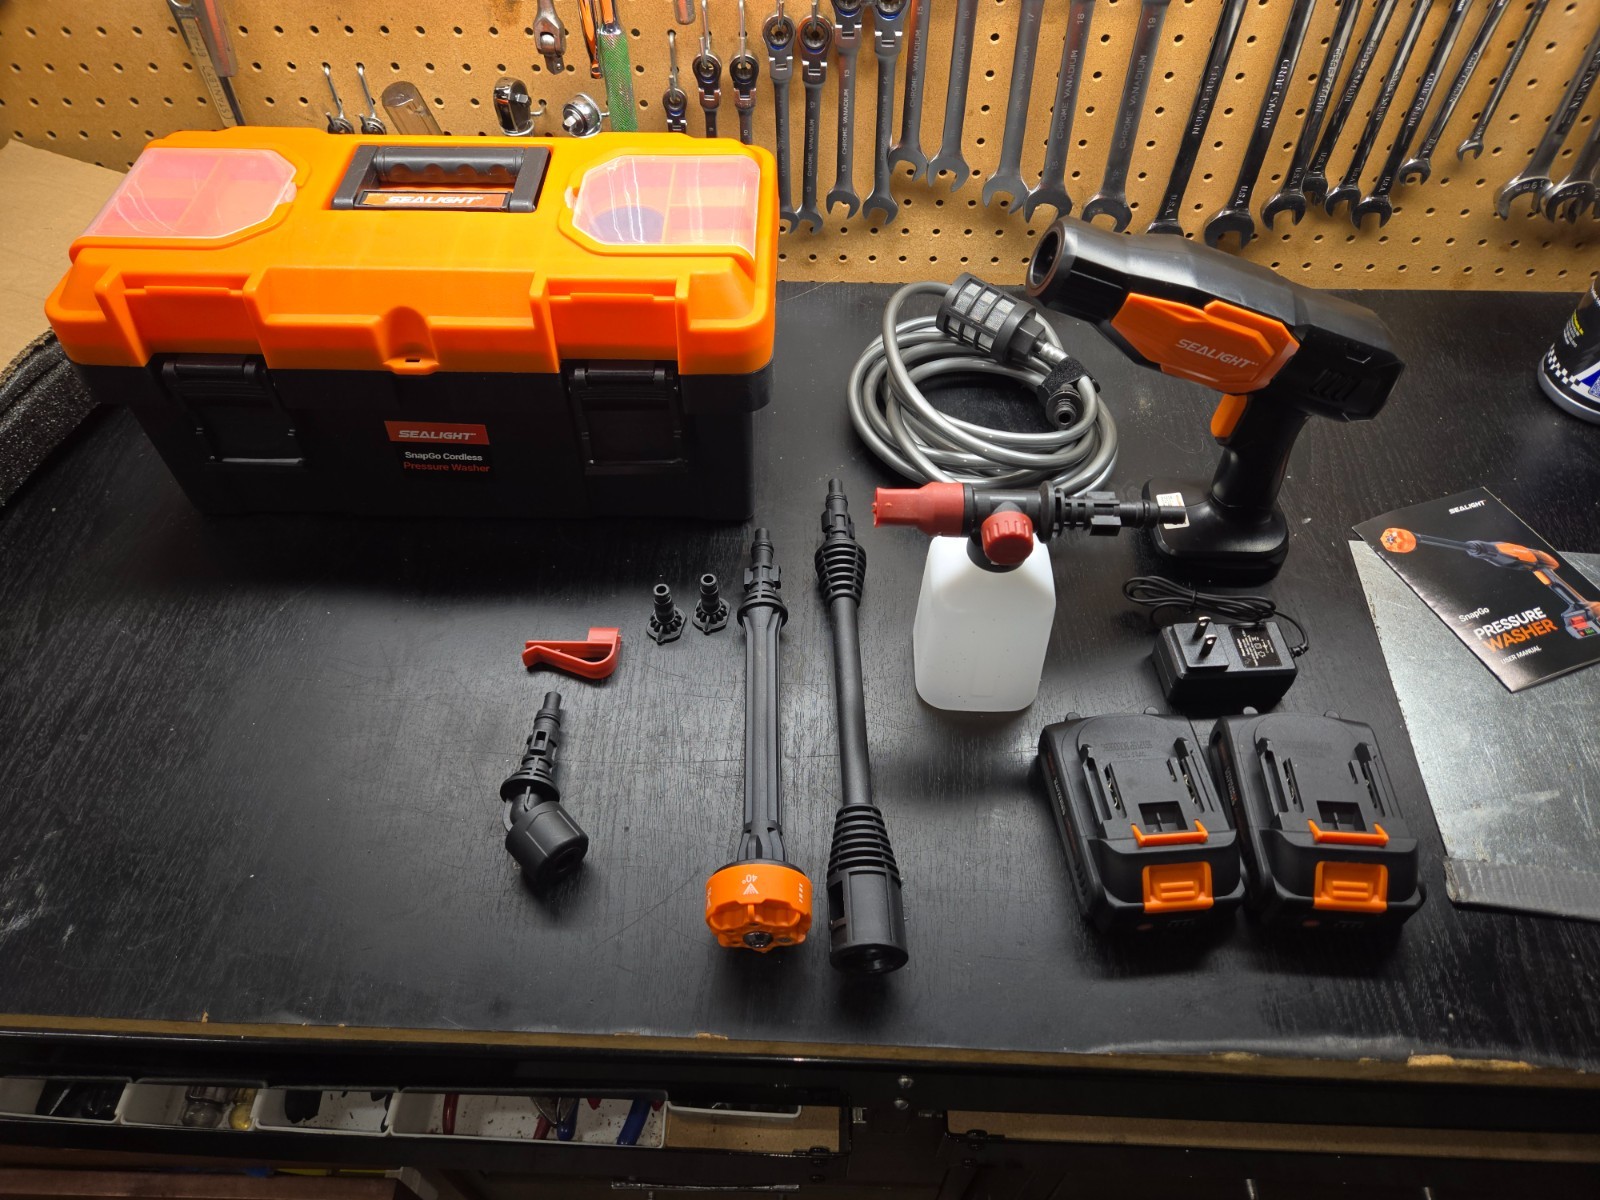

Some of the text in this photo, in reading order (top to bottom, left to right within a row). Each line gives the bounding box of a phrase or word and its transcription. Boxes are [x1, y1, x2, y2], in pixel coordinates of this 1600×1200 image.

[917, 6, 924, 15] 15
[1027, 13, 1035, 23] 17
[912, 29, 922, 72] VANADIUM
[883, 76, 889, 84] 14
[1056, 102, 1069, 139] CHROME
[1063, 49, 1078, 98] VANADIUM
[1077, 13, 1085, 24] 18
[1119, 110, 1134, 149] CHROME
[1129, 54, 1147, 105] VANADIUM
[1147, 17, 1156, 28] 19
[207, 70, 230, 114] STANLEY
[909, 75, 918, 108] CHROME
[1261, 59, 1290, 128] CRAFTSMAN
[810, 101, 816, 109] 12
[841, 164, 847, 172] 13
[844, 69, 850, 77] 13
[385, 195, 480, 205] SEALIGHT
[1176, 338, 1252, 369] SEALIGHT
[398, 429, 472, 441] SEALIGHT
[404, 451, 483, 462] SnapGo Cordless
[403, 461, 491, 473] Pressure Washer
[1448, 499, 1486, 515] SEALIGHT
[1458, 607, 1490, 623] SnapGo
[1473, 606, 1547, 640] PRESSURE
[1483, 618, 1558, 653] WASHER
[1500, 645, 1542, 665] USER MANUAL
